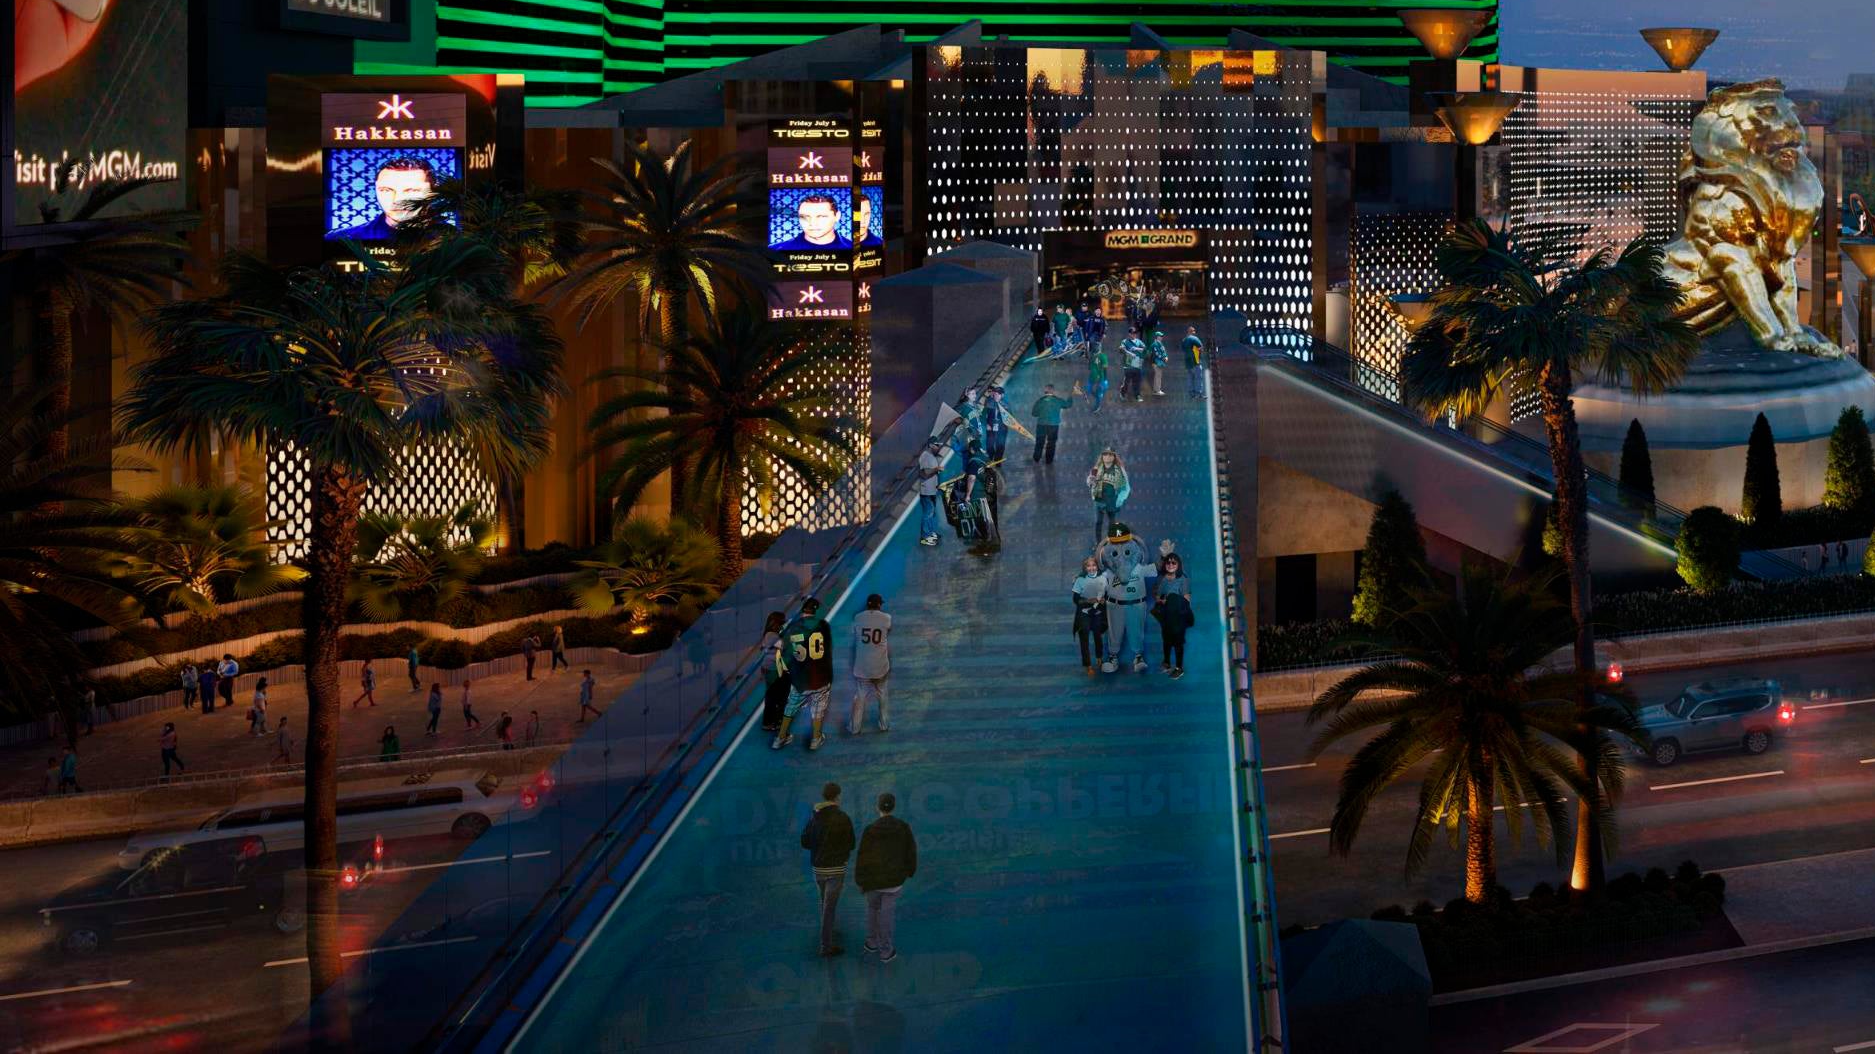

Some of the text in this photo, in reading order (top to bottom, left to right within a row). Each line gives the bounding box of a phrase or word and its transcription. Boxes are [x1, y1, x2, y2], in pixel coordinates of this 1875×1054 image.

[334, 126, 452, 140] Hakkasan
[14, 149, 46, 183] isit
[772, 173, 849, 184] Hakkasan
[1107, 234, 1193, 246] MGM GRAND
[364, 247, 396, 256] riday
[772, 307, 849, 319] Hakkasan
[861, 628, 883, 645] 50
